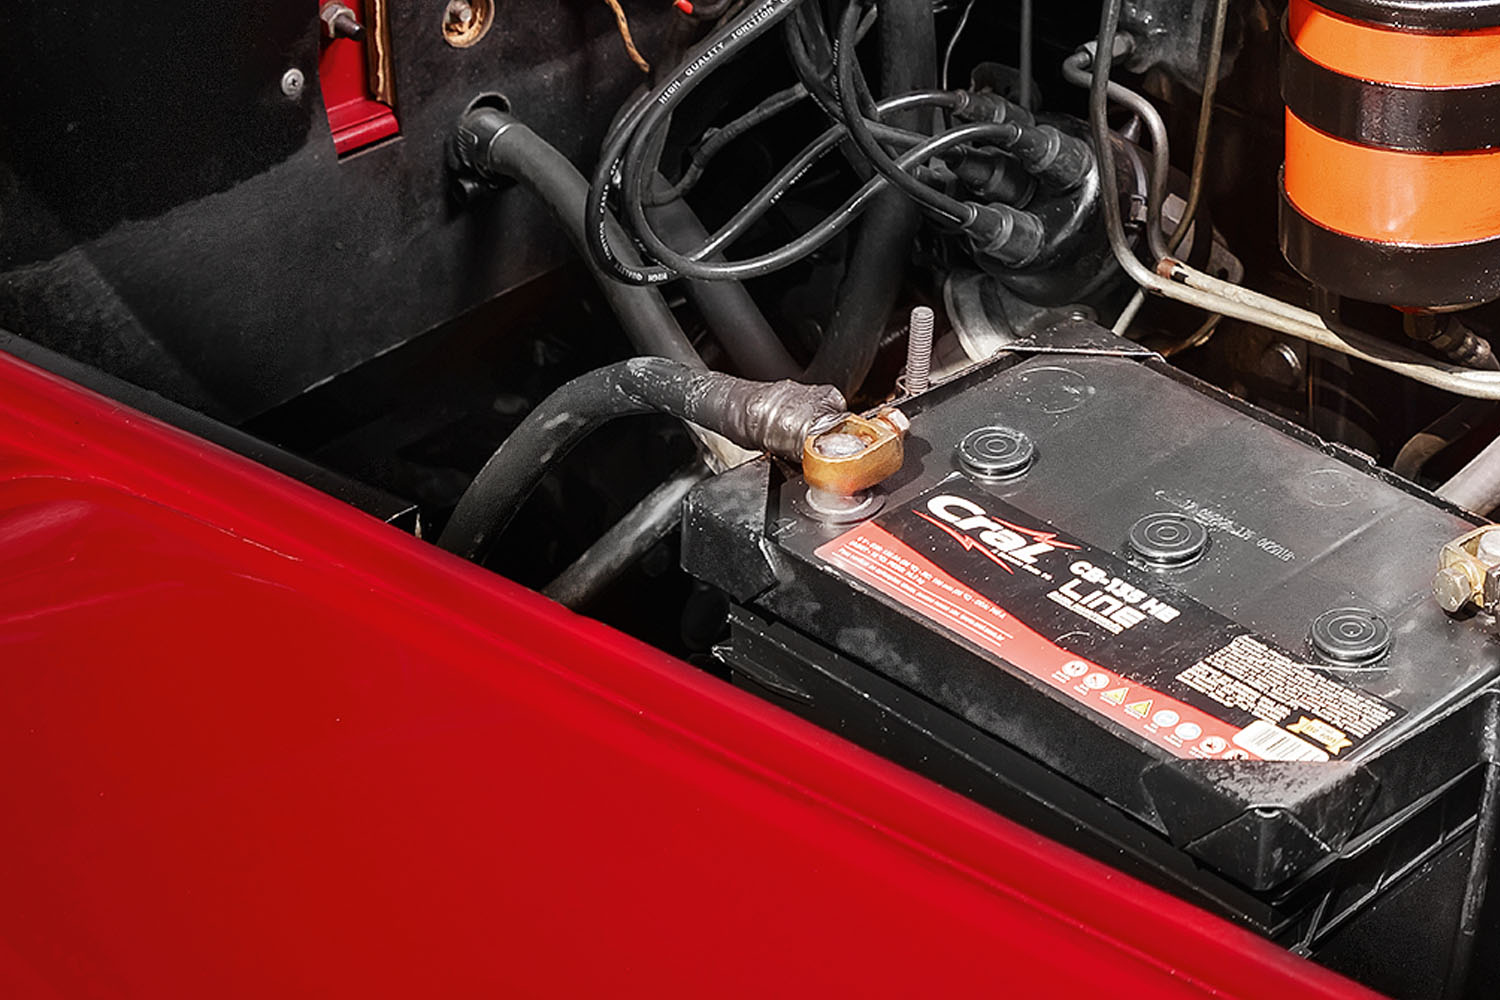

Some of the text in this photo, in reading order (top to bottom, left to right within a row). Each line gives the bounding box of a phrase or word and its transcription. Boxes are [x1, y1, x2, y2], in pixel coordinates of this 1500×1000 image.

[658, 80, 682, 105] HIGH
[683, 41, 726, 77] QUALITY
[730, 3, 774, 41] IGNITION
[926, 492, 1055, 562] Cral
[1057, 577, 1147, 629] LINE
